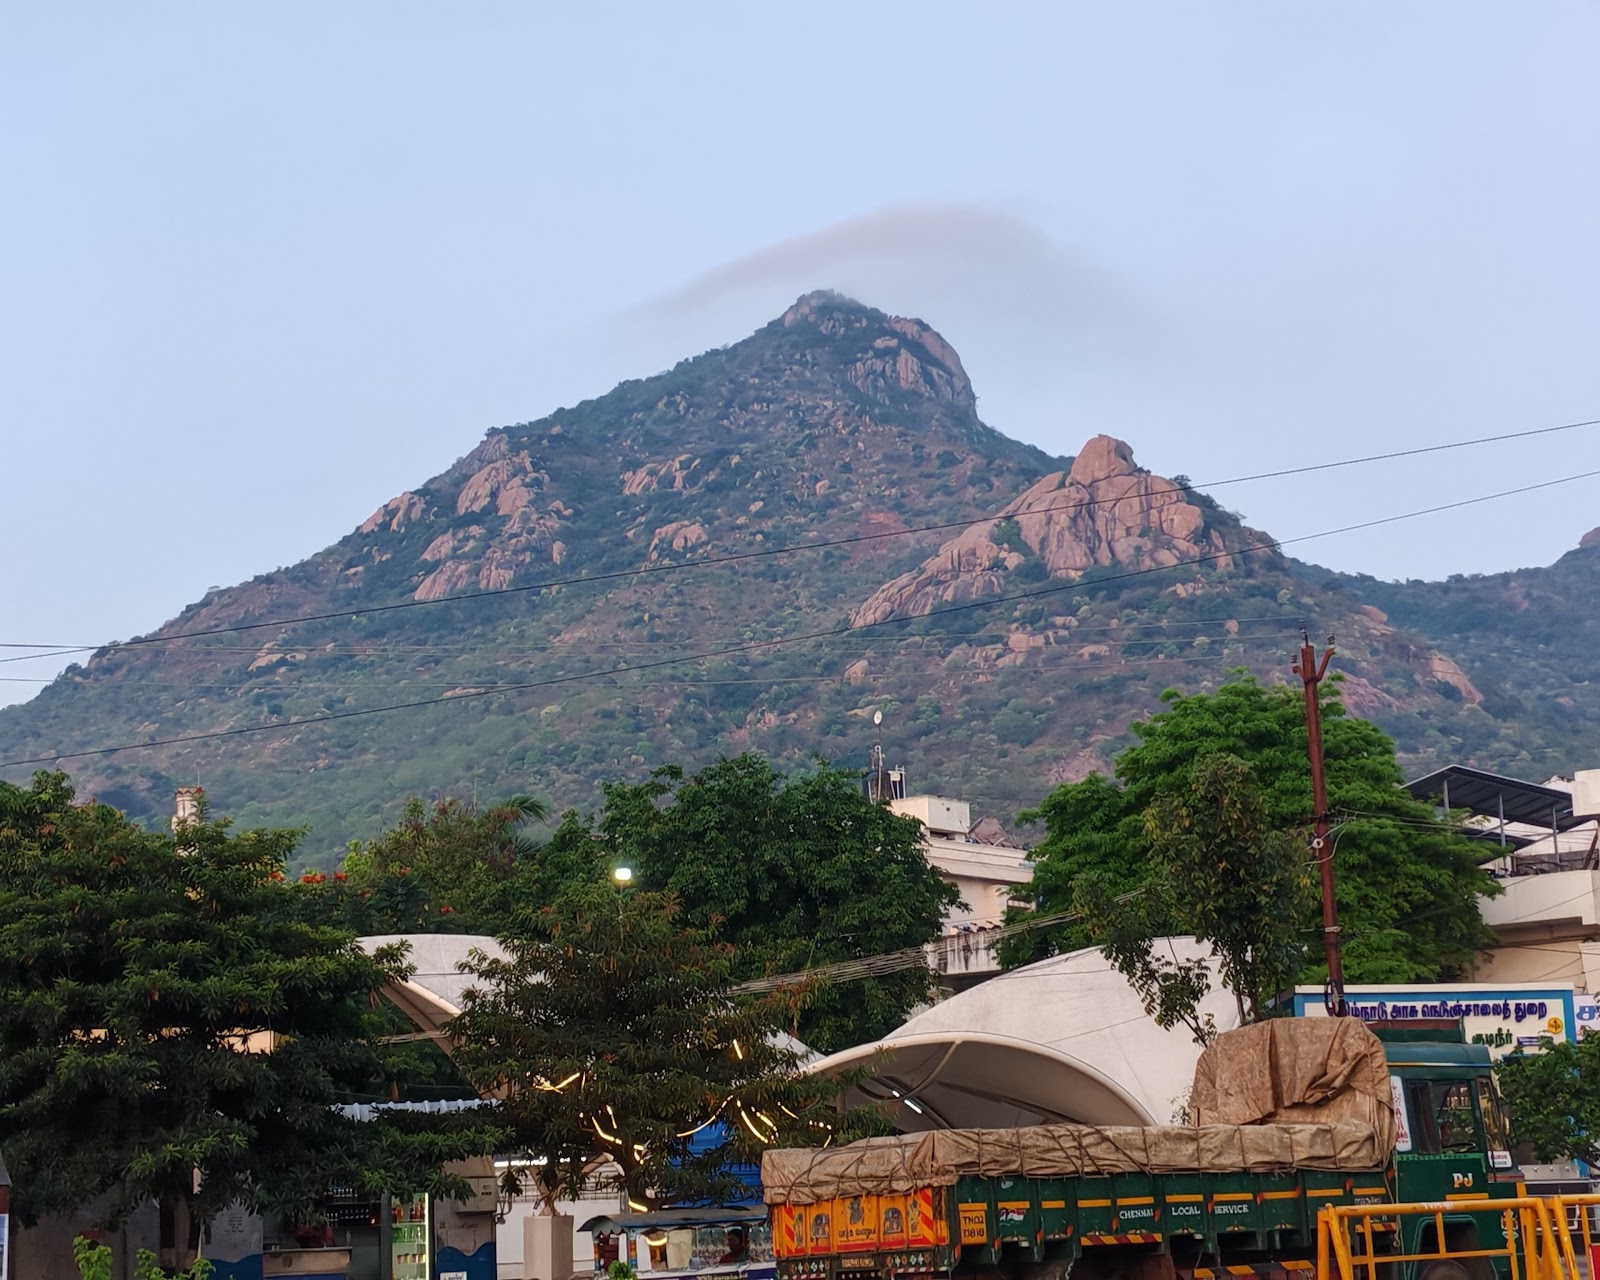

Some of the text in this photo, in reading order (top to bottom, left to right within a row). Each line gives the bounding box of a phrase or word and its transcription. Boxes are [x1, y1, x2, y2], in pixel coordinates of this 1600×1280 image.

[1514, 1002, 1548, 1023] துறை
[1119, 1204, 1249, 1219] CHENNAI LOCAL SERVICE
